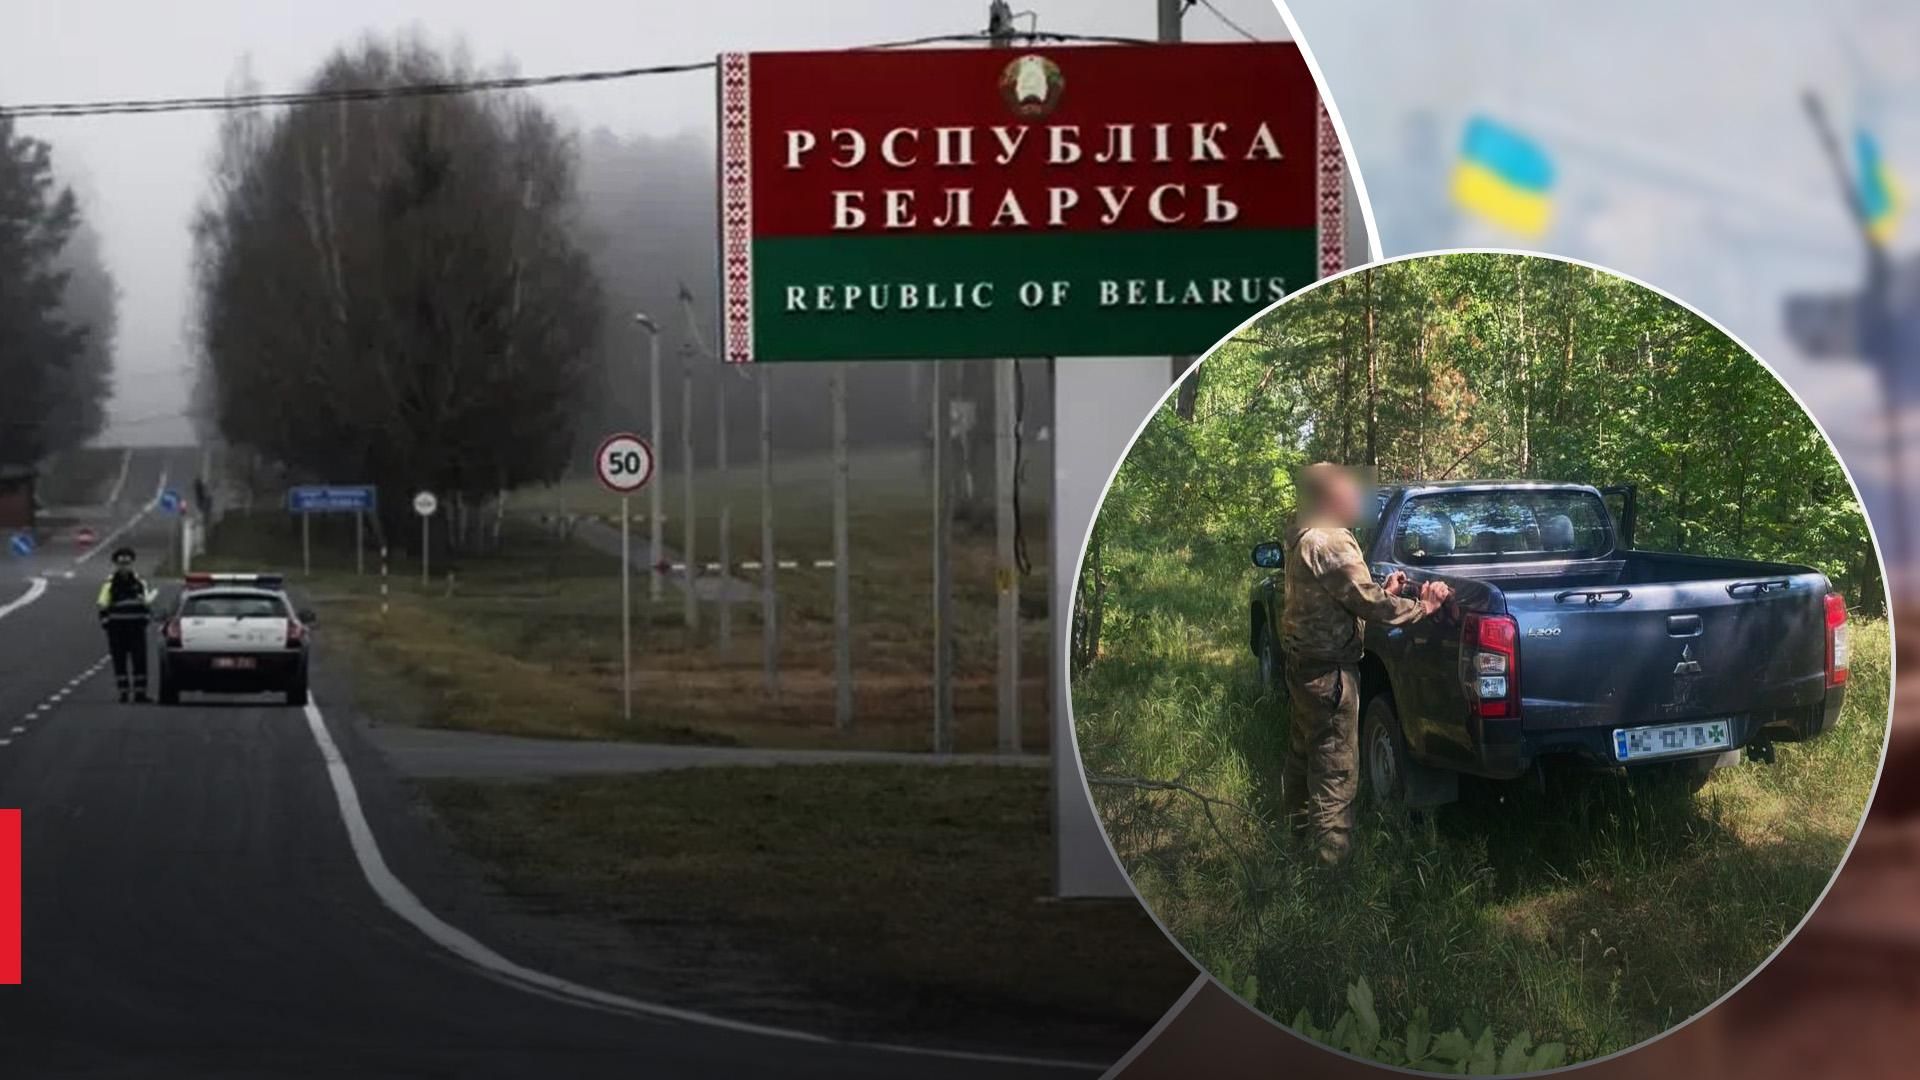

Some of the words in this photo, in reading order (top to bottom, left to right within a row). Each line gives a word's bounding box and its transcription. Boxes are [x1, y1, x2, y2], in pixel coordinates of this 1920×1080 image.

[784, 122, 1284, 169] РЭСПУБЛІКА
[831, 183, 1239, 229] БЕЛАРУСЬ
[785, 281, 993, 311] REPUBLIC
[1018, 280, 1071, 308] OF
[1100, 276, 1286, 305] BELARUS
[610, 451, 640, 475] 50
[1527, 627, 1562, 636] L200
